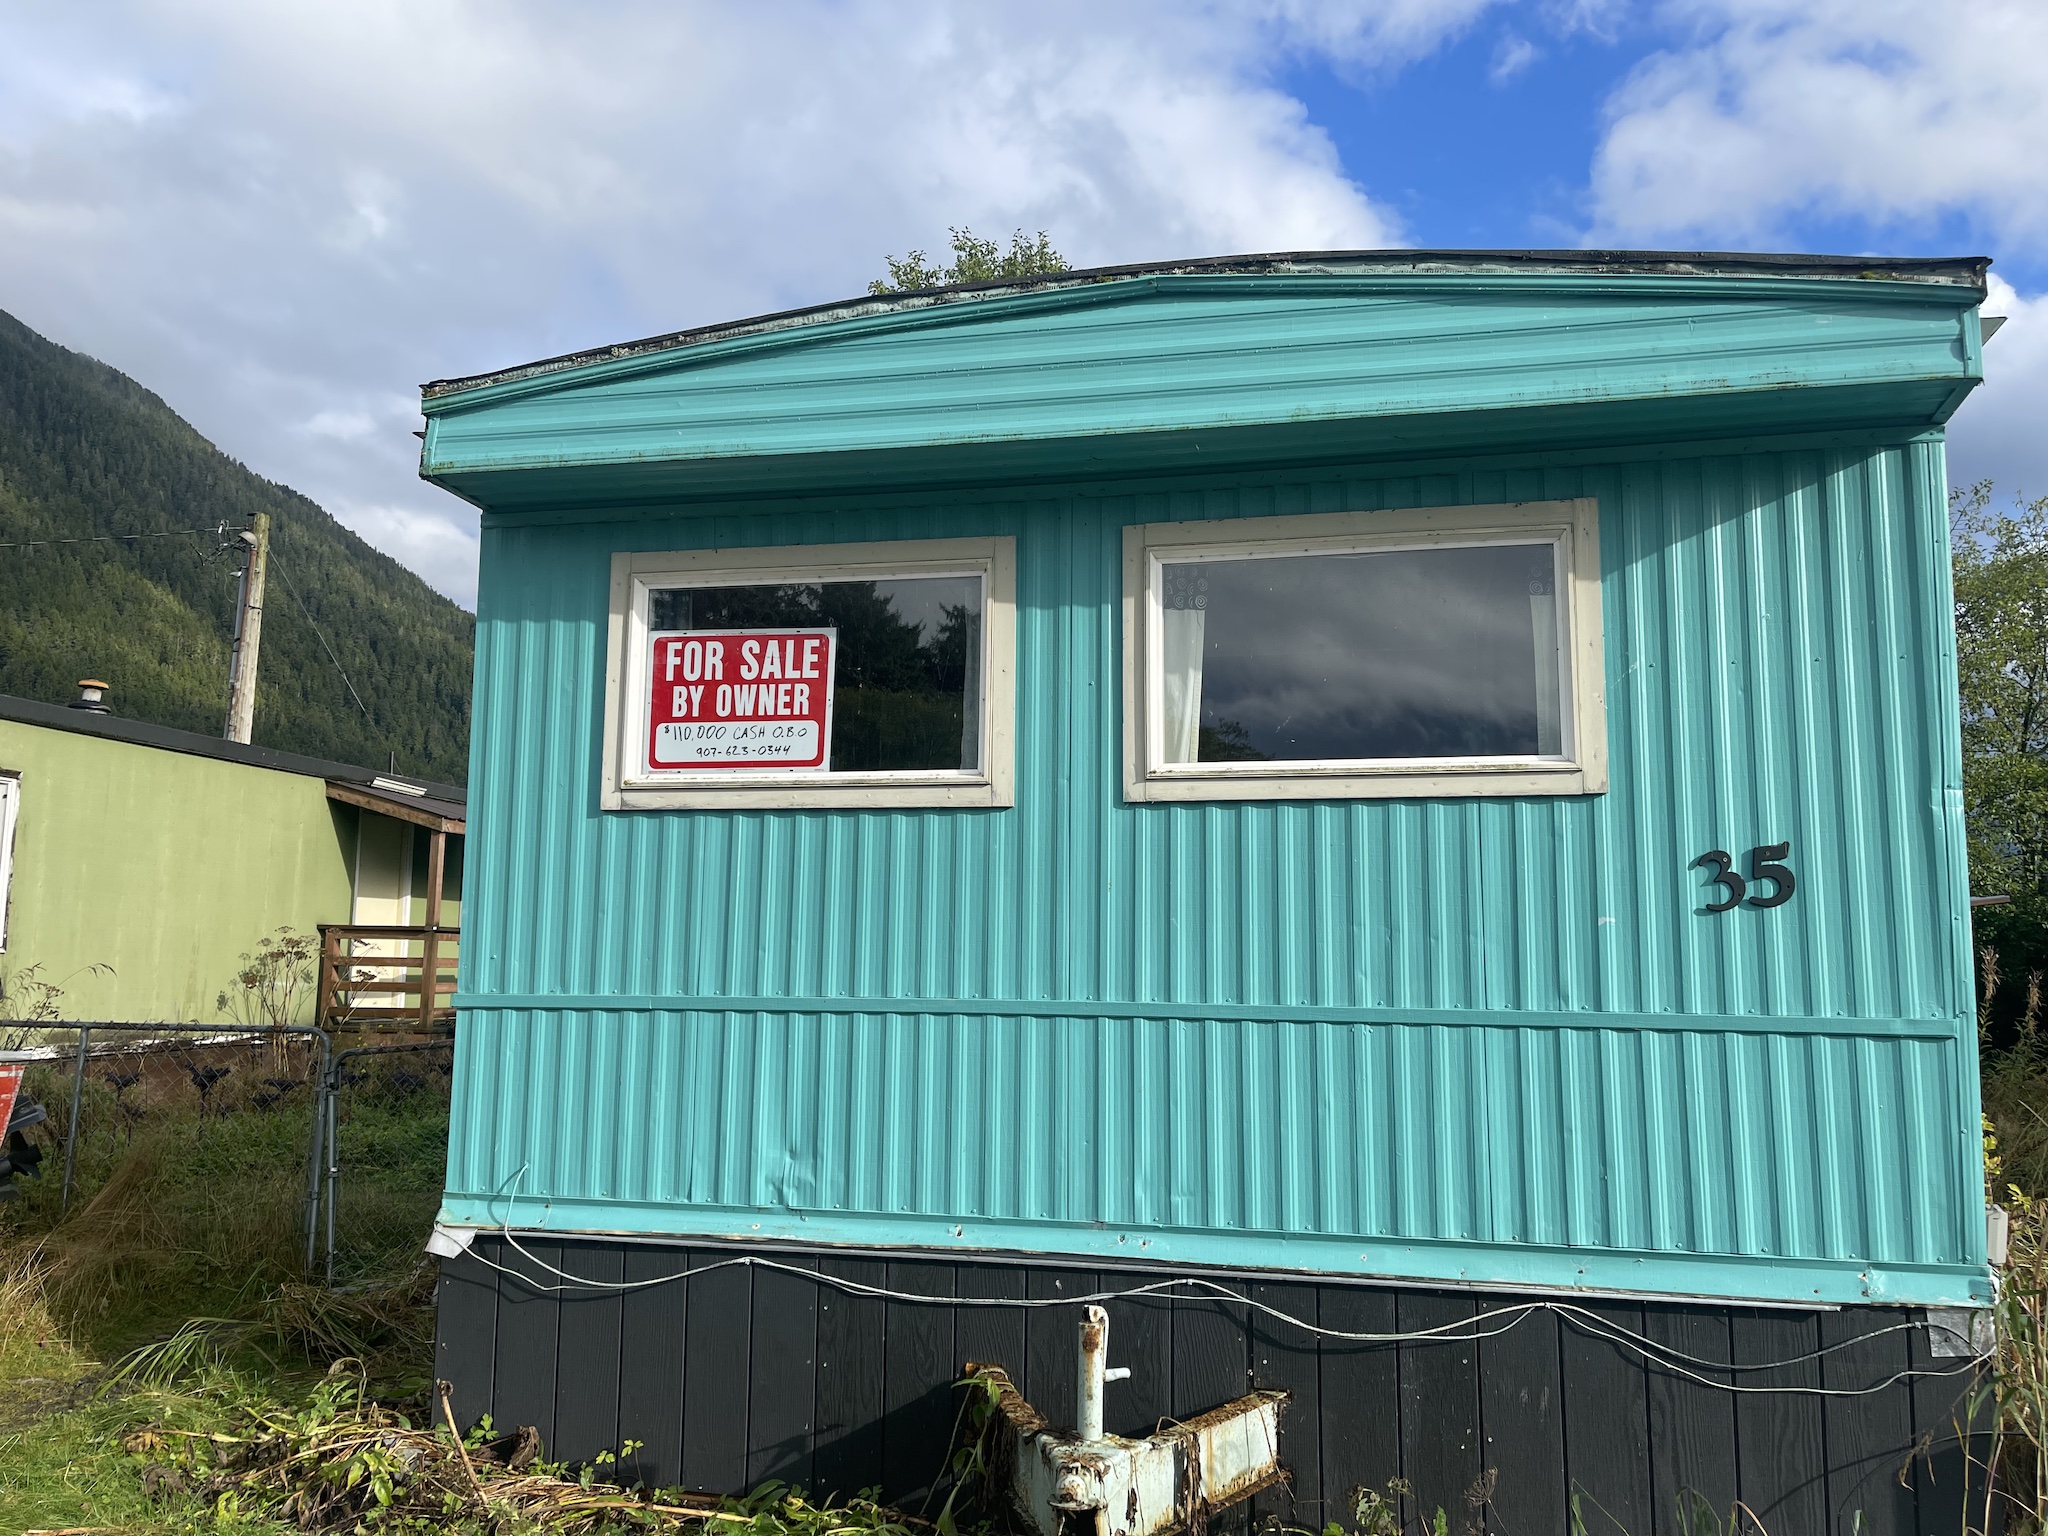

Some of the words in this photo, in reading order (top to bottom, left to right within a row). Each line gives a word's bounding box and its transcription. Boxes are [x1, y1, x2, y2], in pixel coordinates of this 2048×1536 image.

[666, 640, 724, 681] FOR
[740, 639, 820, 680] SALE
[672, 685, 704, 718] BY
[715, 683, 810, 717] OWNER
[664, 725, 727, 741] $110,000
[733, 725, 765, 740] CASH
[696, 745, 791, 757] 907-623-0344
[1699, 841, 1796, 912] 35
